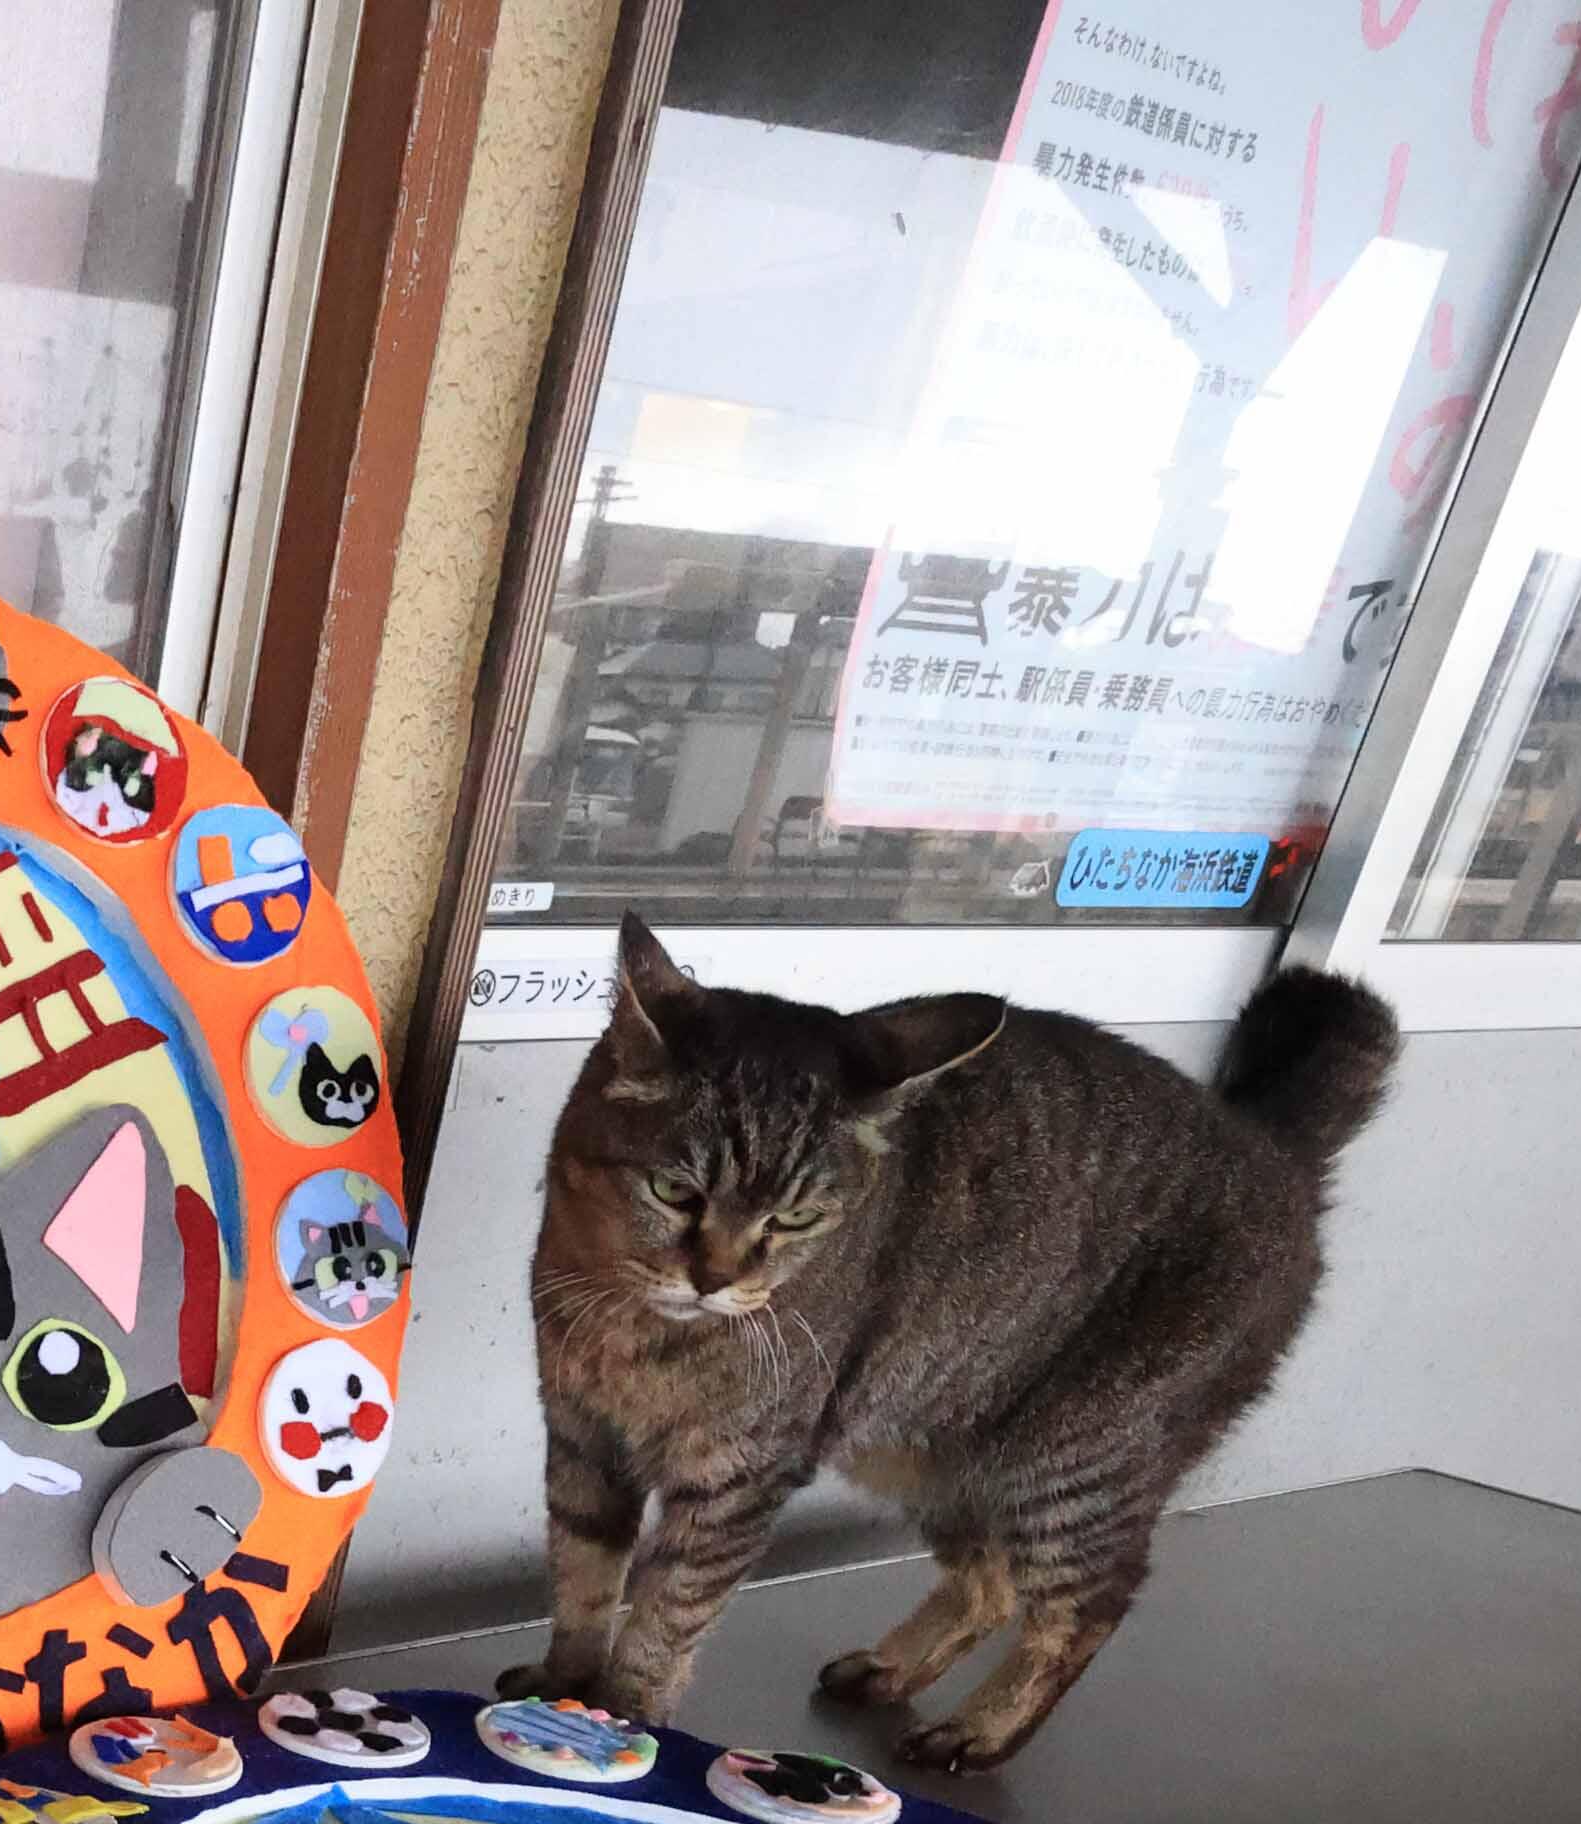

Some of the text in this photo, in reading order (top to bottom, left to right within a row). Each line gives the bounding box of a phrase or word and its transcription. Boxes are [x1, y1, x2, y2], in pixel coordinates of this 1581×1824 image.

[1073, 17, 1227, 96] そんなわけ、ないですよね。
[1049, 79, 1260, 164] 2018年度の鉄道係員に対する
[1068, 846, 1260, 893] ひたちなか海浜鉄道
